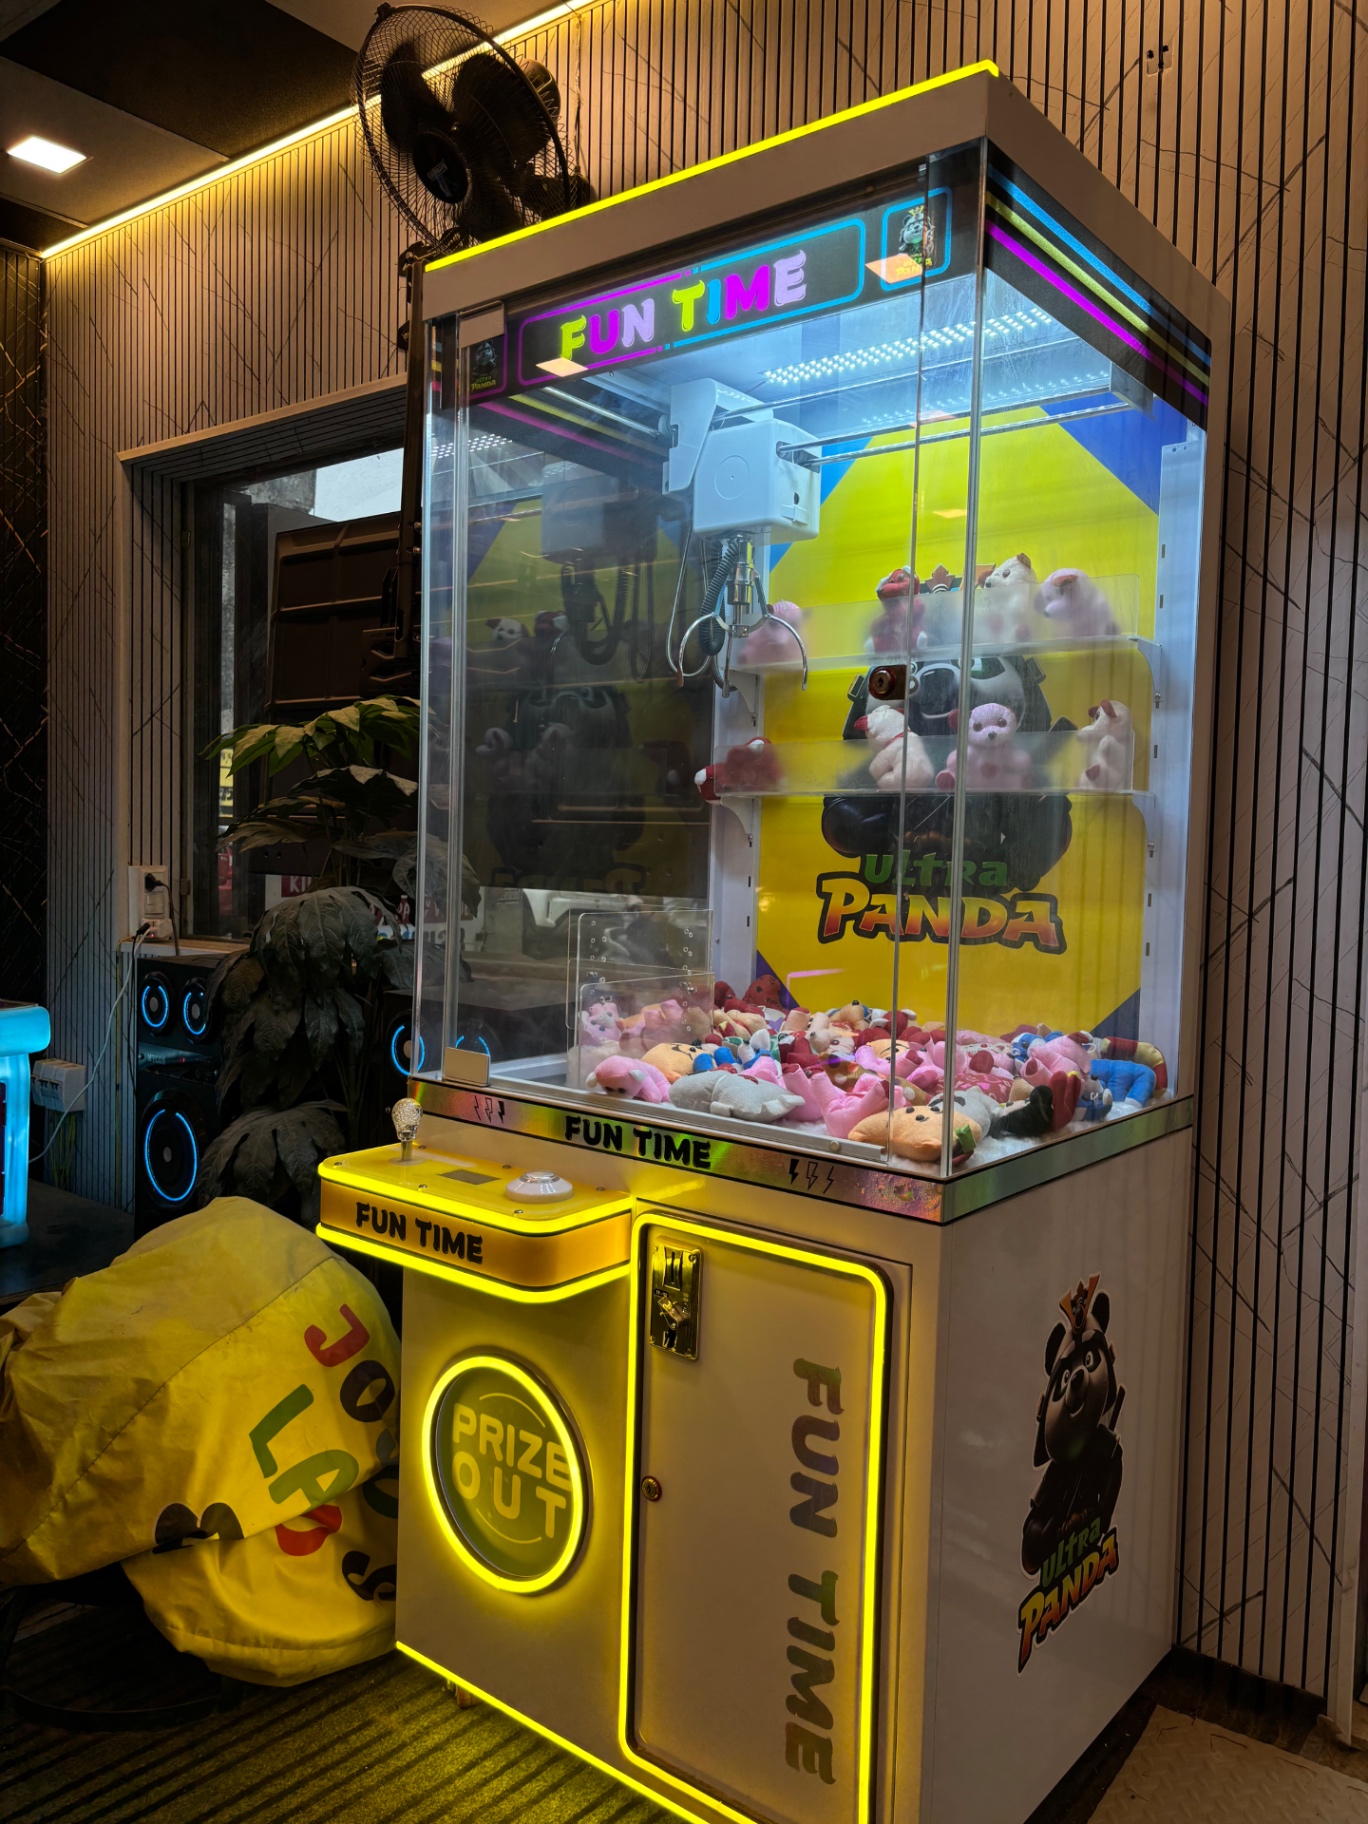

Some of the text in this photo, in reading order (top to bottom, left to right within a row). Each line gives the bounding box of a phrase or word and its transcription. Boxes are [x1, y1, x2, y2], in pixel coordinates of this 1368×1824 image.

[561, 250, 806, 360] FUN TIME
[819, 875, 1062, 950] PANDA
[565, 1115, 711, 1169] FUN TIME
[355, 1202, 484, 1264] FUN TIME
[451, 1402, 573, 1492] PRIZE
[451, 1450, 567, 1539] OUT
[785, 1357, 845, 1785] FUN TIME
[1019, 1533, 1118, 1667] PANDA
